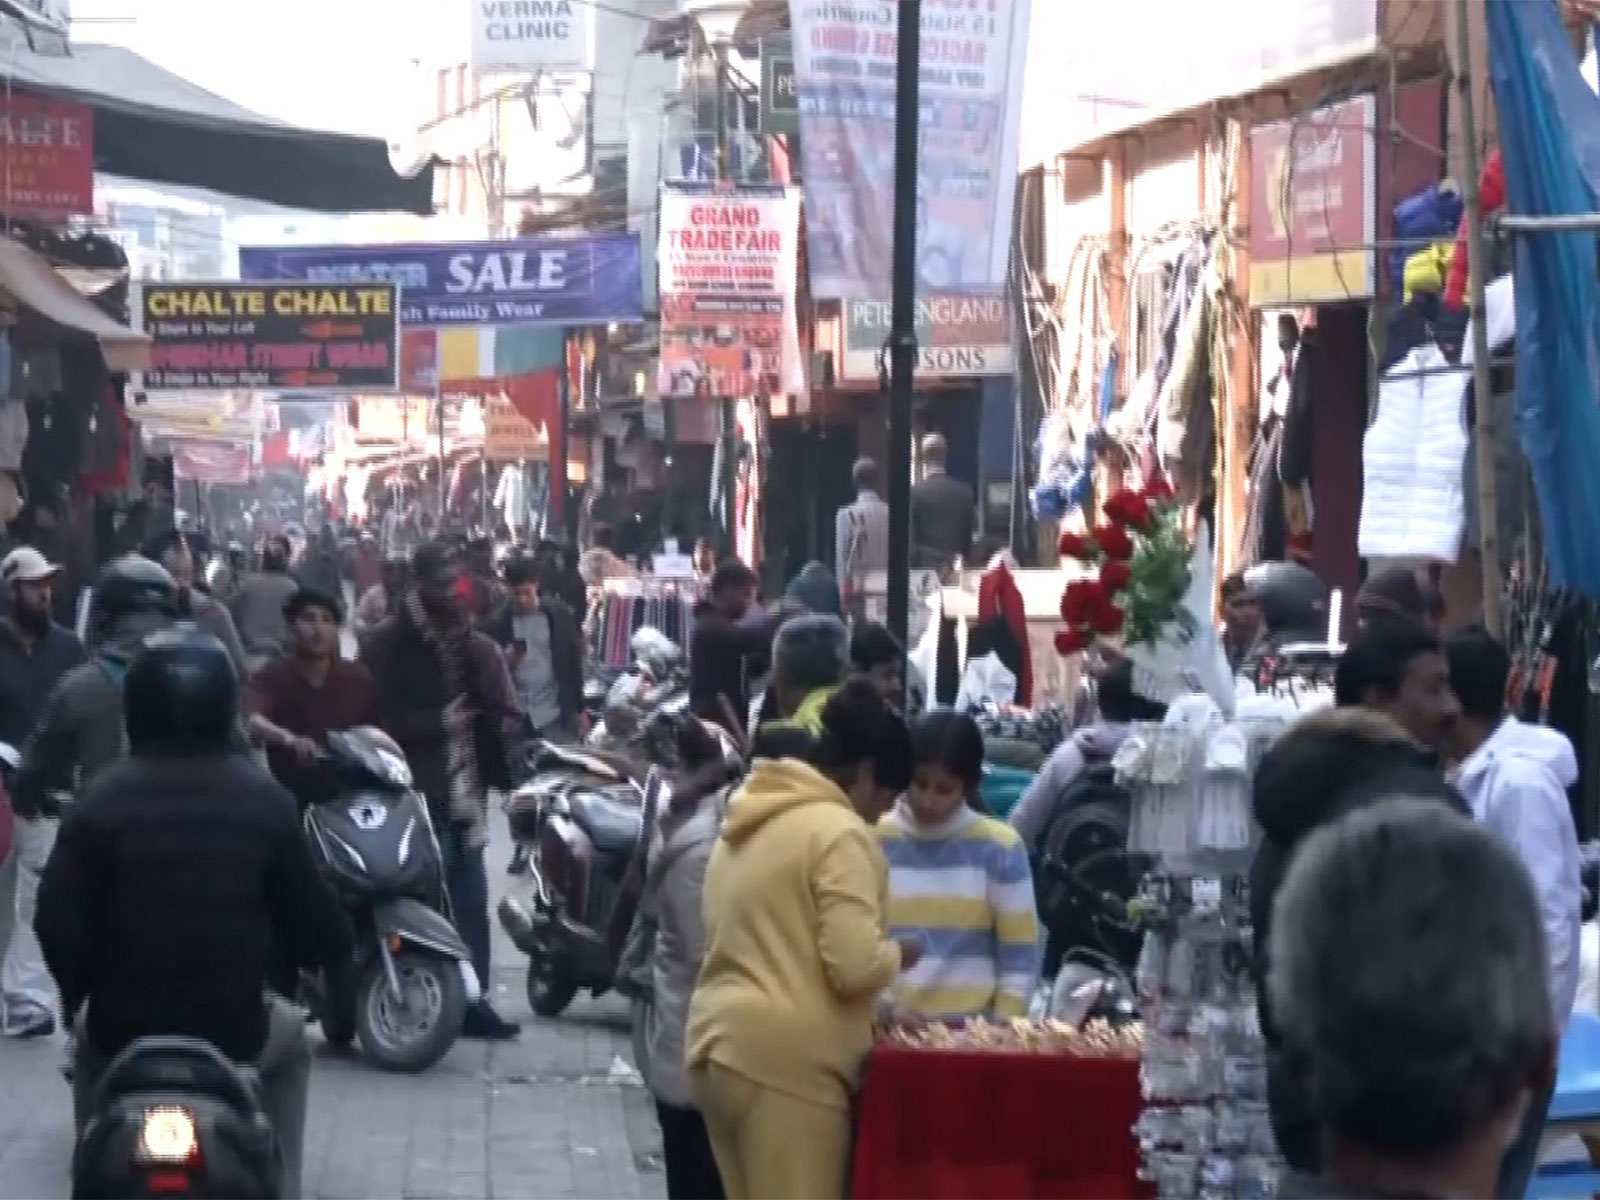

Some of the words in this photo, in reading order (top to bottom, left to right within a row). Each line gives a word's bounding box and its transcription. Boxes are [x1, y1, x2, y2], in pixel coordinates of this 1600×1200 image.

[482, 0, 573, 18] VERMA
[485, 21, 569, 41] CLINIC
[690, 205, 760, 225] GRAND
[445, 250, 568, 293] SALE
[149, 291, 265, 316] CHALTE
[273, 290, 391, 316] CHALTE
[424, 303, 490, 322] Family
[496, 301, 544, 318] Wear
[853, 300, 894, 328] PETE
[923, 350, 986, 371] SONS
